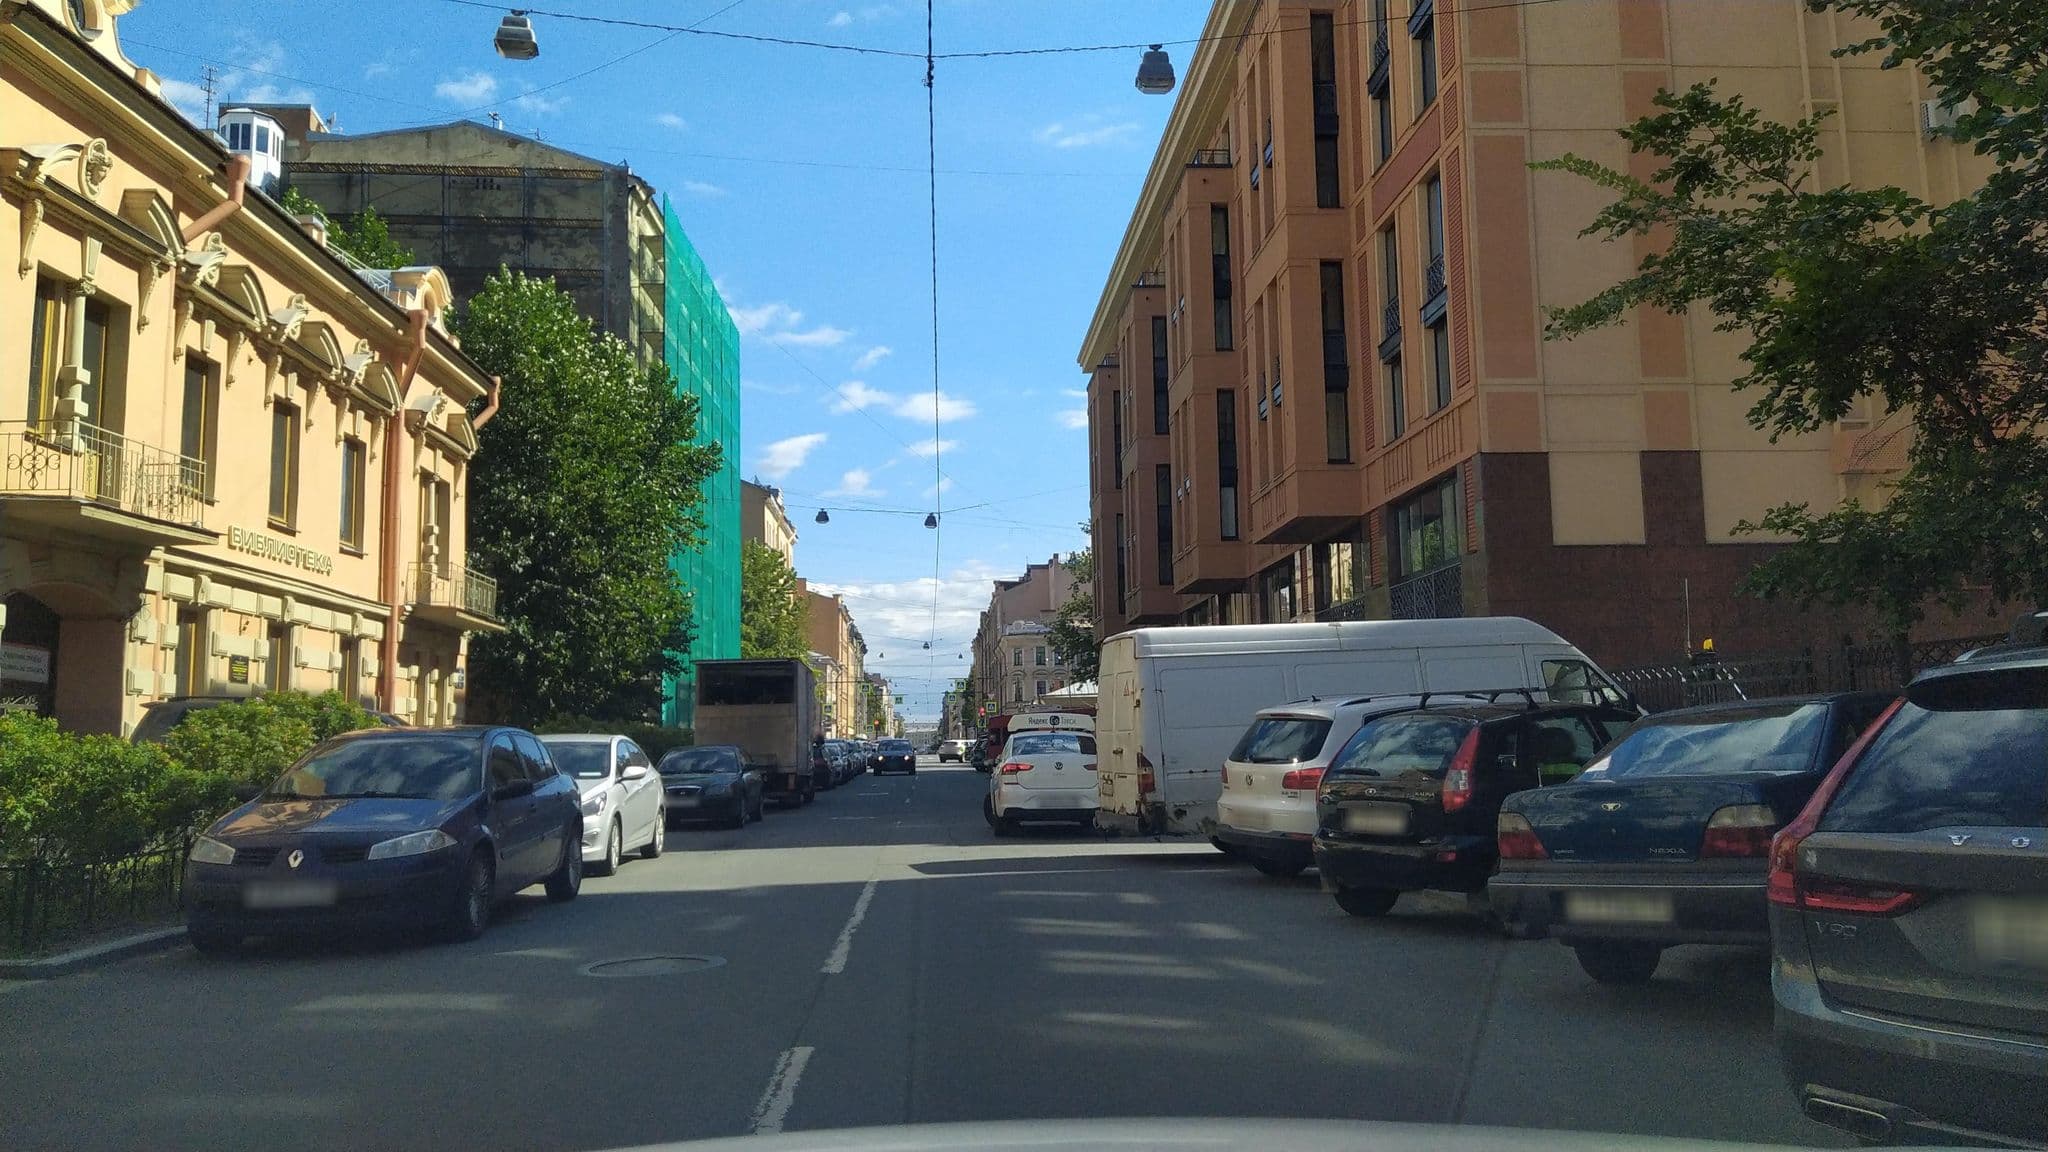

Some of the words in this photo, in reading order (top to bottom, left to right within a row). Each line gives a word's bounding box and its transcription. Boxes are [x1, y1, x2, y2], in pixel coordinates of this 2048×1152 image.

[228, 525, 332, 574] БИБЛИОТЕКА
[1028, 716, 1048, 725] Яндекс
[1648, 846, 1687, 854] NEXIA
